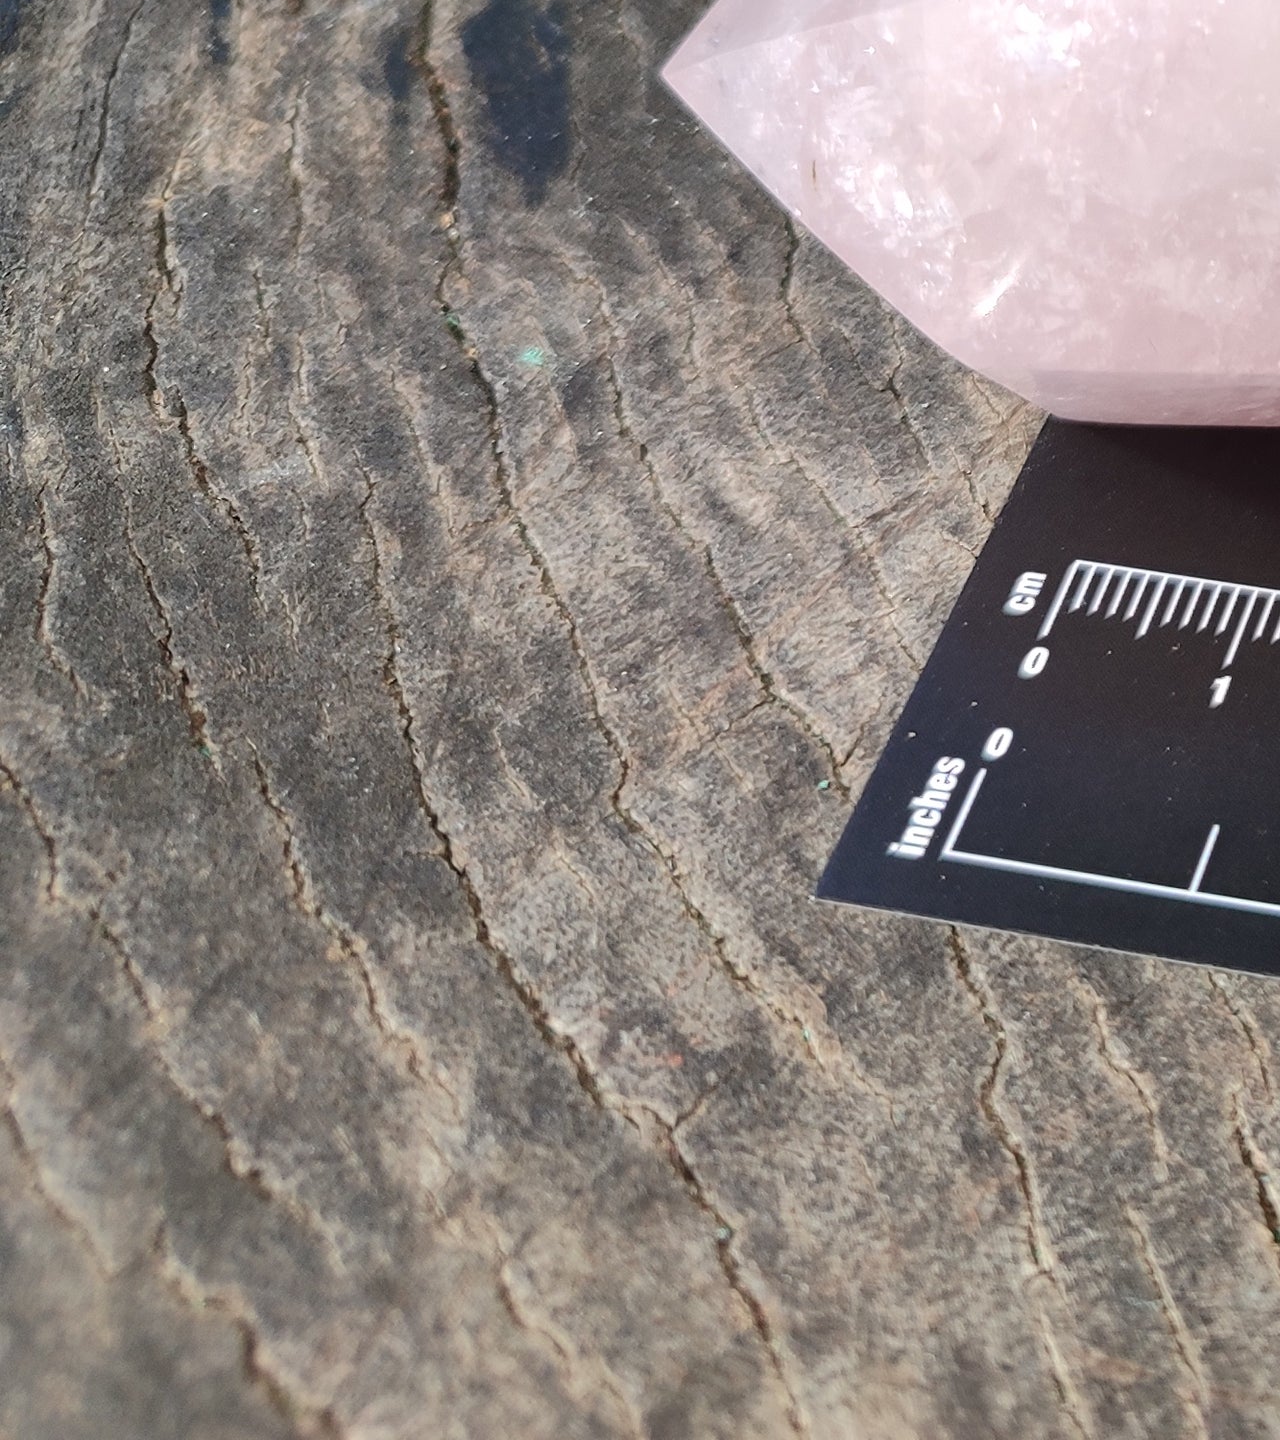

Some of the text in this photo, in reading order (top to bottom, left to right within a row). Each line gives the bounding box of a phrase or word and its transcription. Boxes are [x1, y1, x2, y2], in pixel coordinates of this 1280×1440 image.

[1002, 569, 1049, 617] cm
[1017, 644, 1051, 679] 0
[1208, 674, 1234, 709] 1
[980, 725, 1015, 762] 0
[886, 754, 966, 860] inches
